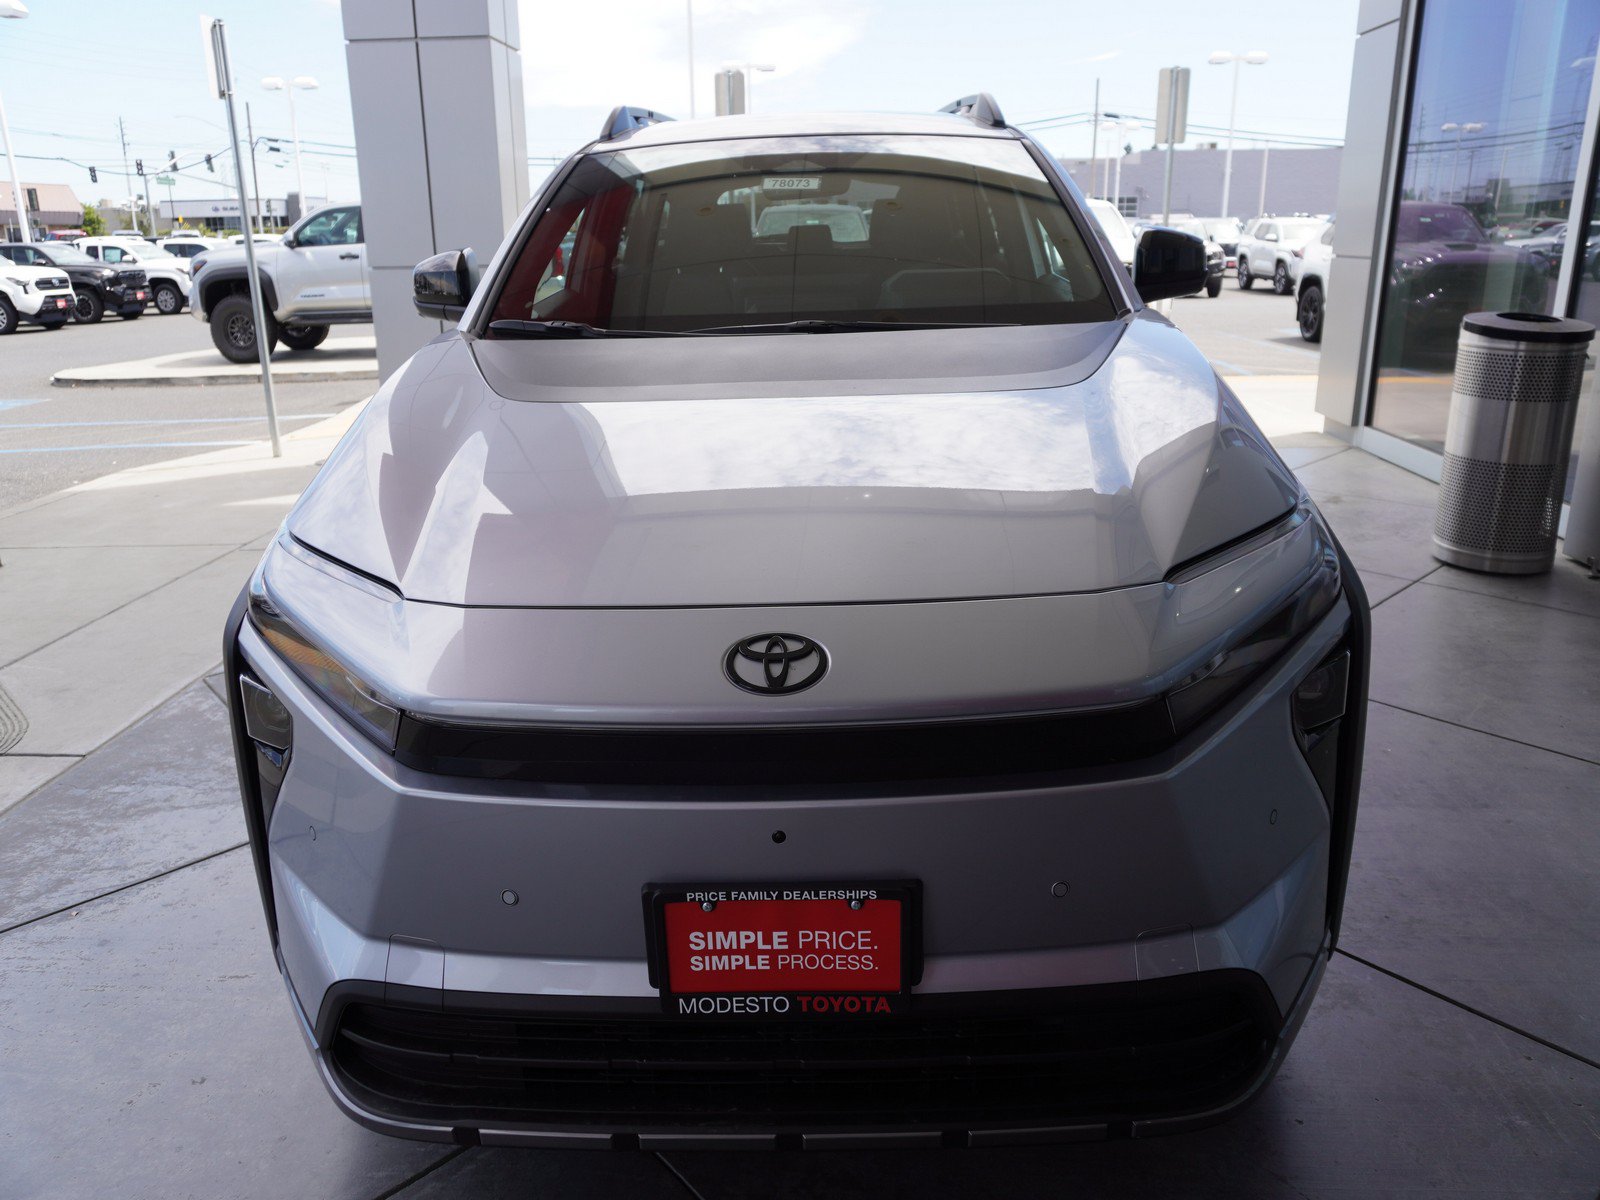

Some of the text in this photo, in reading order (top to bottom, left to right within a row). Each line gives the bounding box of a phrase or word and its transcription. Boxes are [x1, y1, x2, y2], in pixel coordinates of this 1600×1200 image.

[771, 179, 810, 188] 78073
[686, 890, 877, 902] PRICE FAMILY DEALERSHIPS
[689, 930, 878, 950] SIMPLE PRICE.
[690, 955, 879, 971] SIMPLE PROCESS.
[679, 996, 891, 1014] MODESTO TOYOTA
